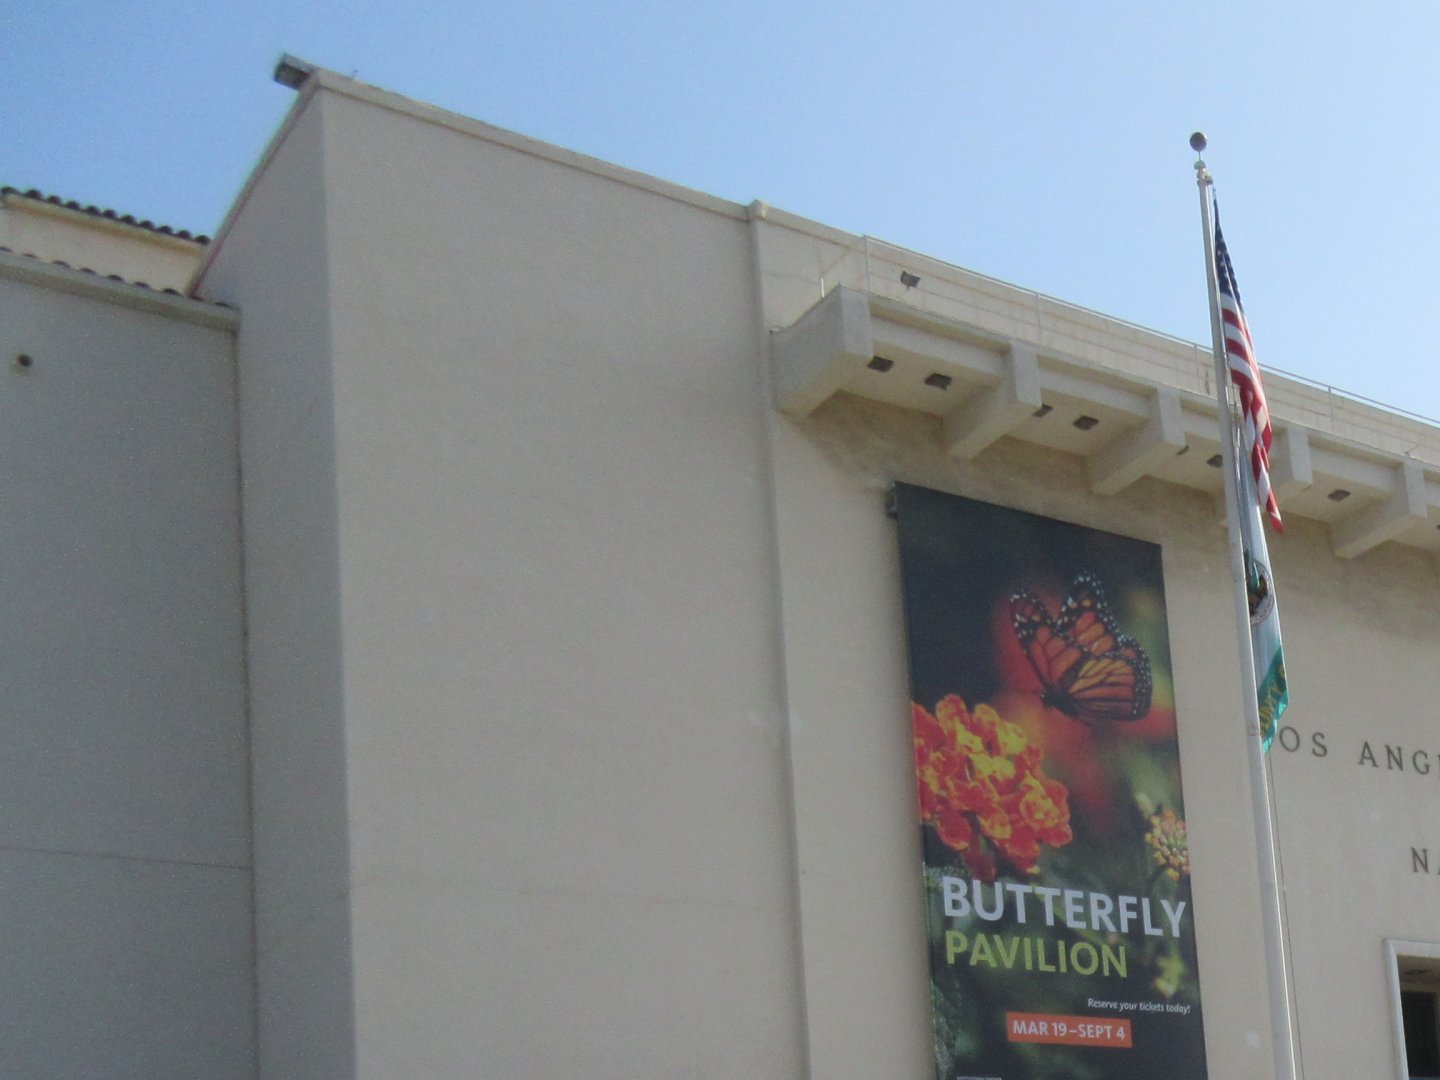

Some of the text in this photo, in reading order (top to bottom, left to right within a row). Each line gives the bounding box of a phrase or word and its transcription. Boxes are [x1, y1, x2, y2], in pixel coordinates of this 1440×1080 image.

[1279, 726, 1328, 758] OS
[942, 876, 1187, 938] BUTTERFLY
[945, 930, 1128, 978] PAVILION
[1087, 998, 1191, 1015] Reserve your tickets today!
[1013, 1020, 1048, 1036] MAR
[1116, 1026, 1126, 1040] 4
